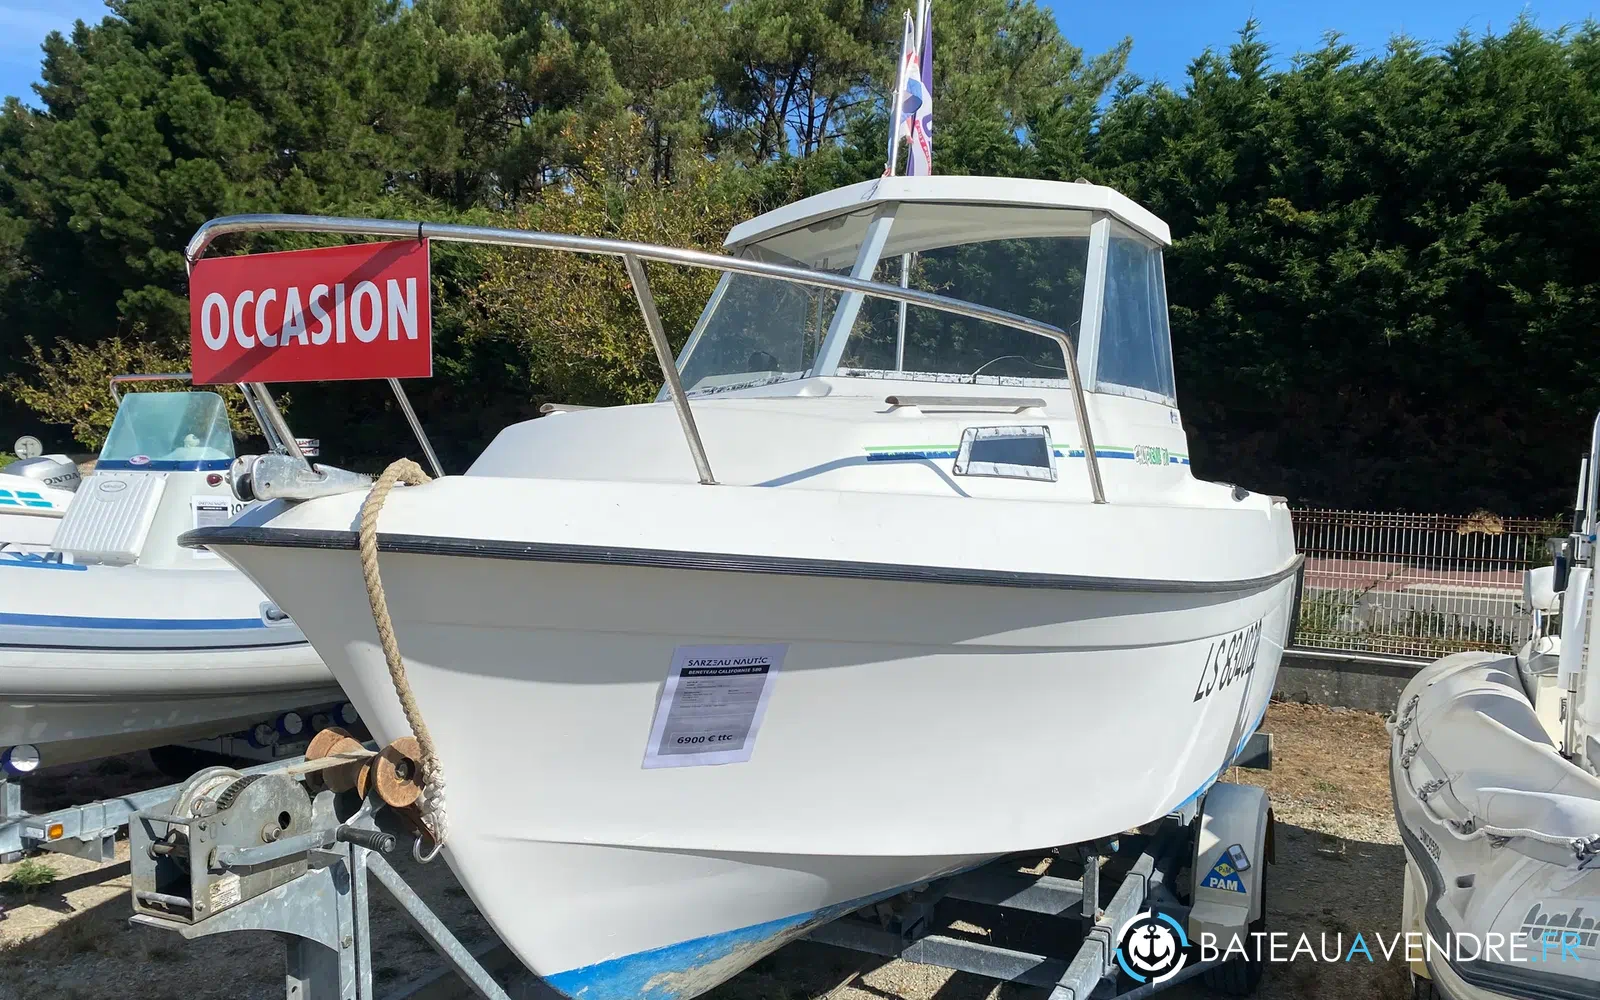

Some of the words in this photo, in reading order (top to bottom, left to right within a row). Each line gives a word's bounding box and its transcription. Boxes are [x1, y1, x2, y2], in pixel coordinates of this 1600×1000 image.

[201, 277, 418, 350] OCCASION
[43, 472, 80, 485] ONDA
[688, 659, 732, 667] SARZEAU
[1193, 638, 1226, 703] LS
[677, 736, 705, 744] 6900
[1209, 877, 1238, 891] PAM
